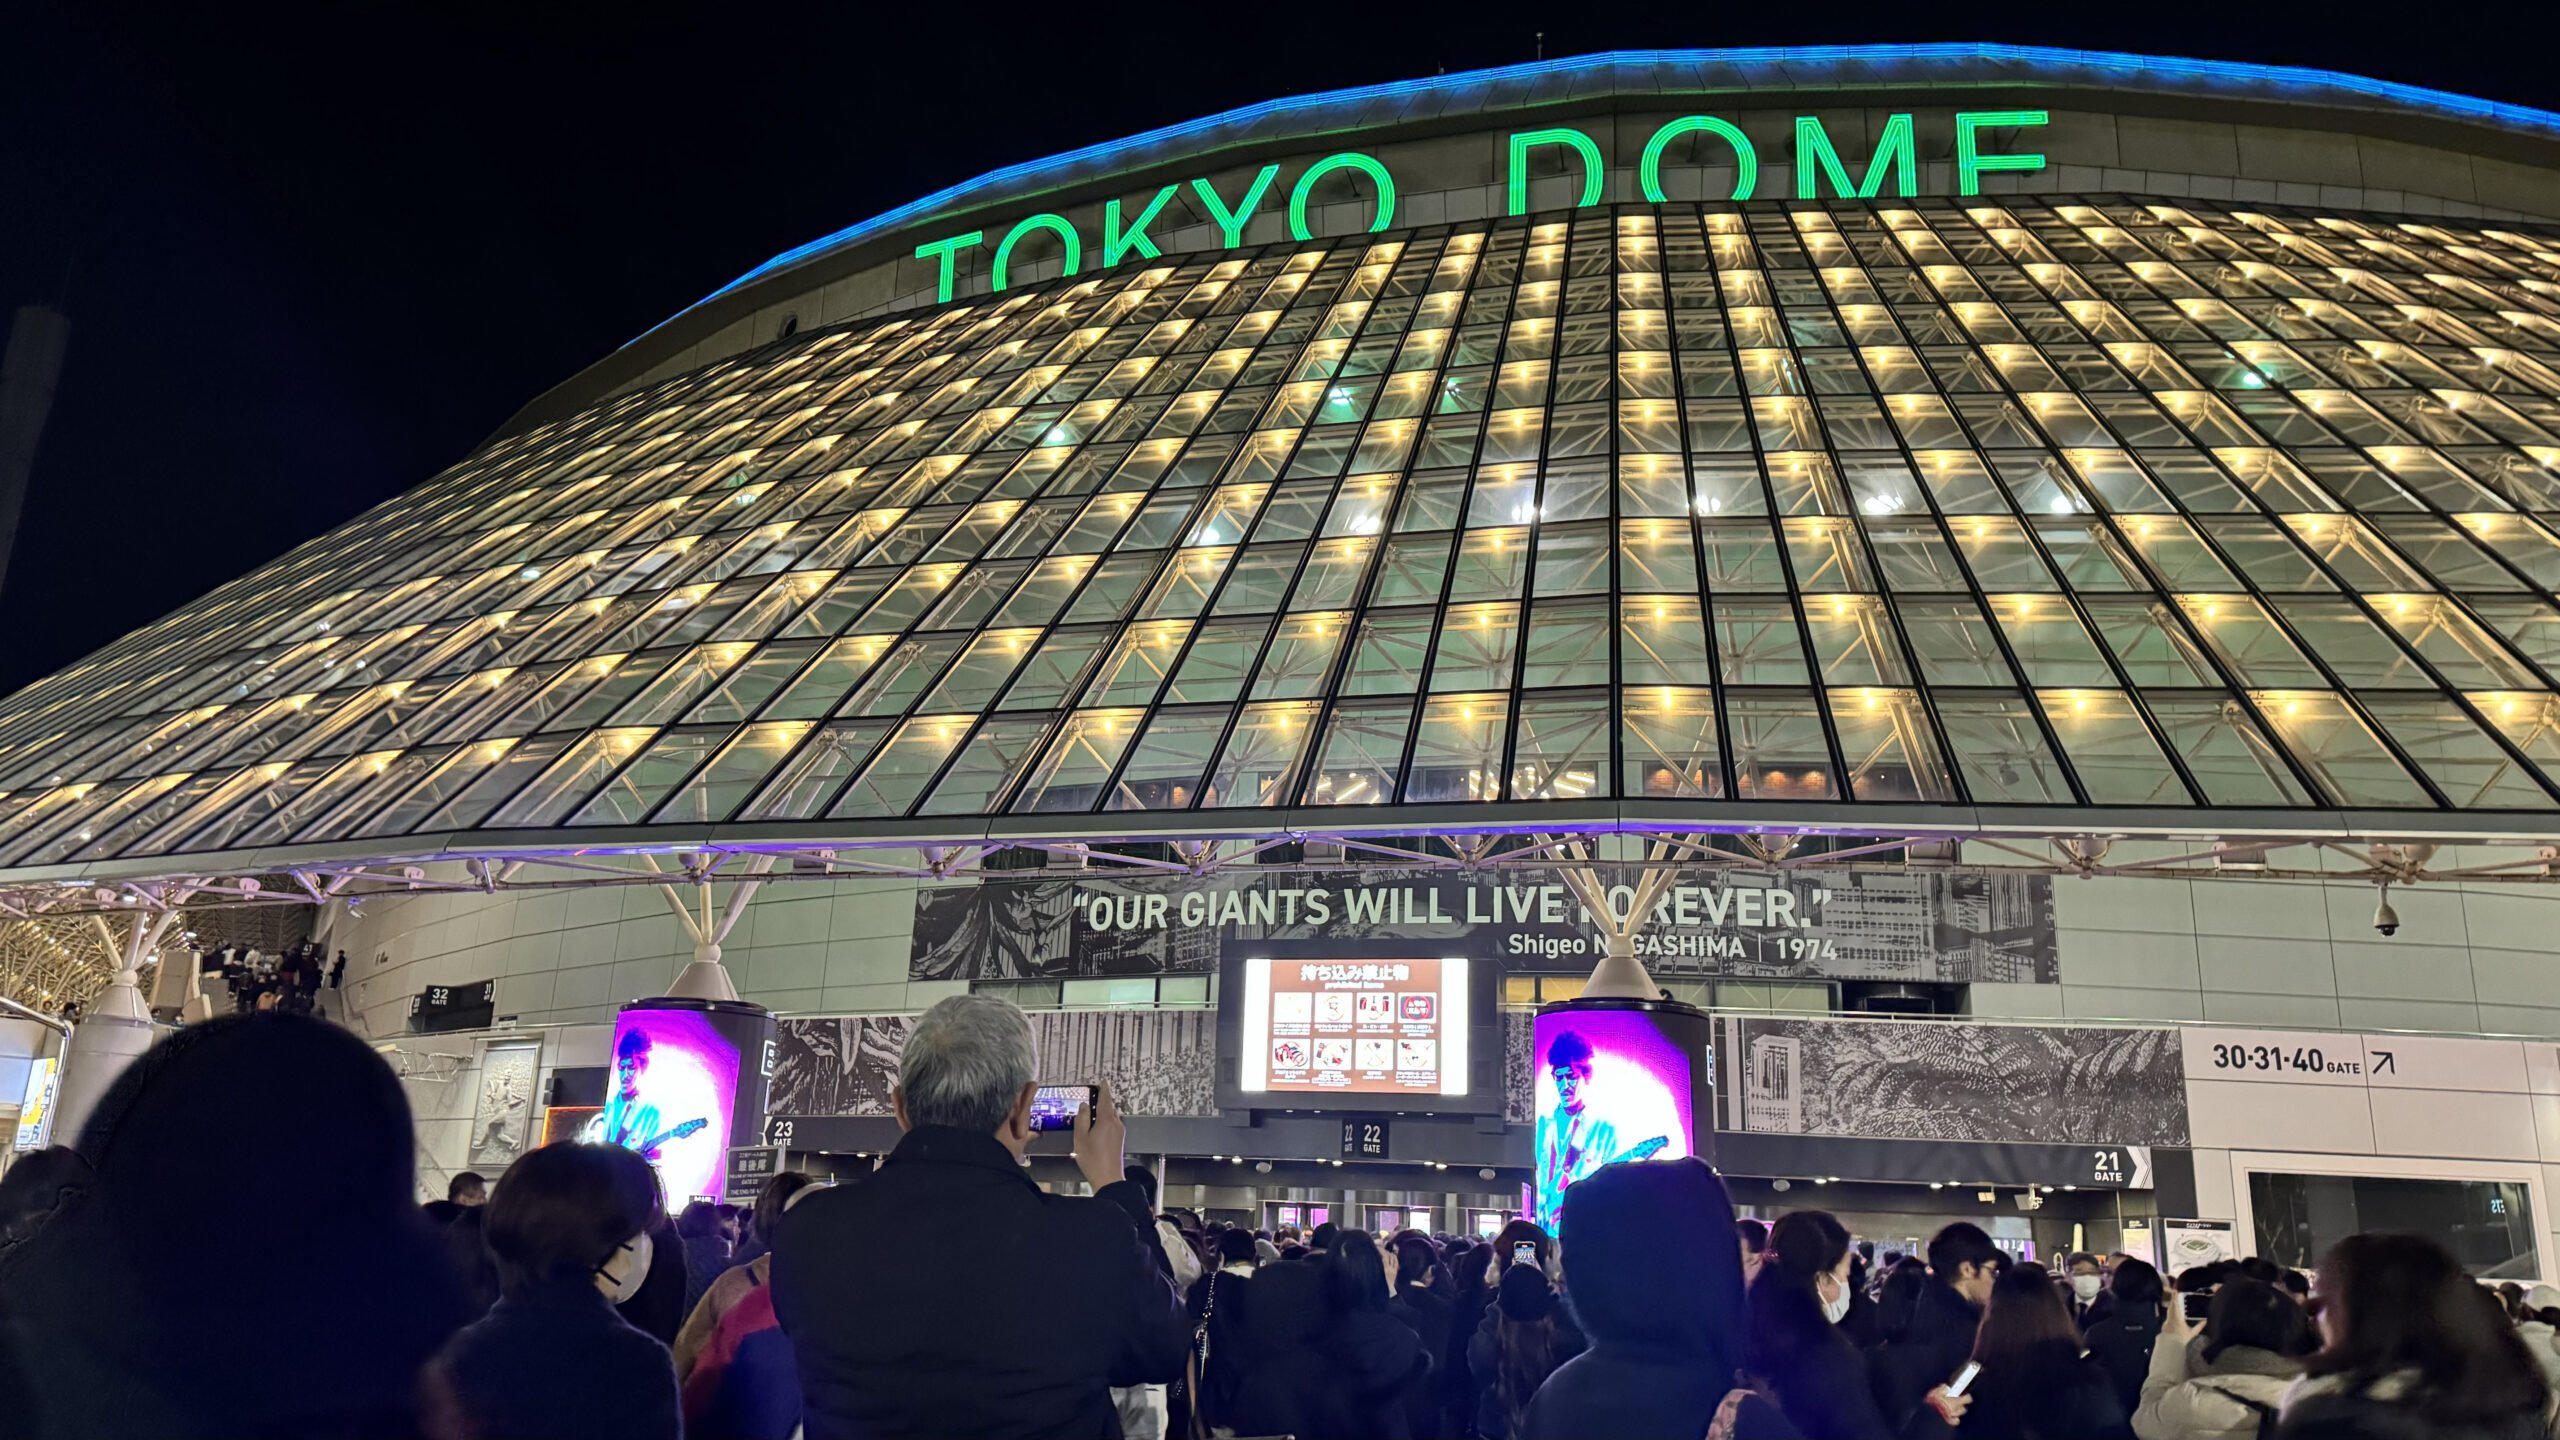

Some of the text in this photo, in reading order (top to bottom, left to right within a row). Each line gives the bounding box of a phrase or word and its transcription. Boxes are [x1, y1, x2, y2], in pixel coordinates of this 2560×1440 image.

[915, 152, 1396, 303] TOKYO
[1073, 893, 1168, 931] “OUR
[1181, 889, 1331, 928] GIANTS
[1344, 888, 1452, 924] WILL
[1467, 886, 1564, 924] LIVE
[1509, 933, 1838, 961] Shigeo NGASHIMA 1974
[432, 988, 449, 999] 32
[2327, 1062, 2361, 1074] GATE
[774, 1121, 793, 1137] 23
[1364, 1124, 1381, 1143] 22
[773, 1138, 792, 1146] GATE
[1363, 1143, 1381, 1153] GATE
[2094, 1151, 2119, 1171] 21
[2094, 1171, 2123, 1182] GATE
